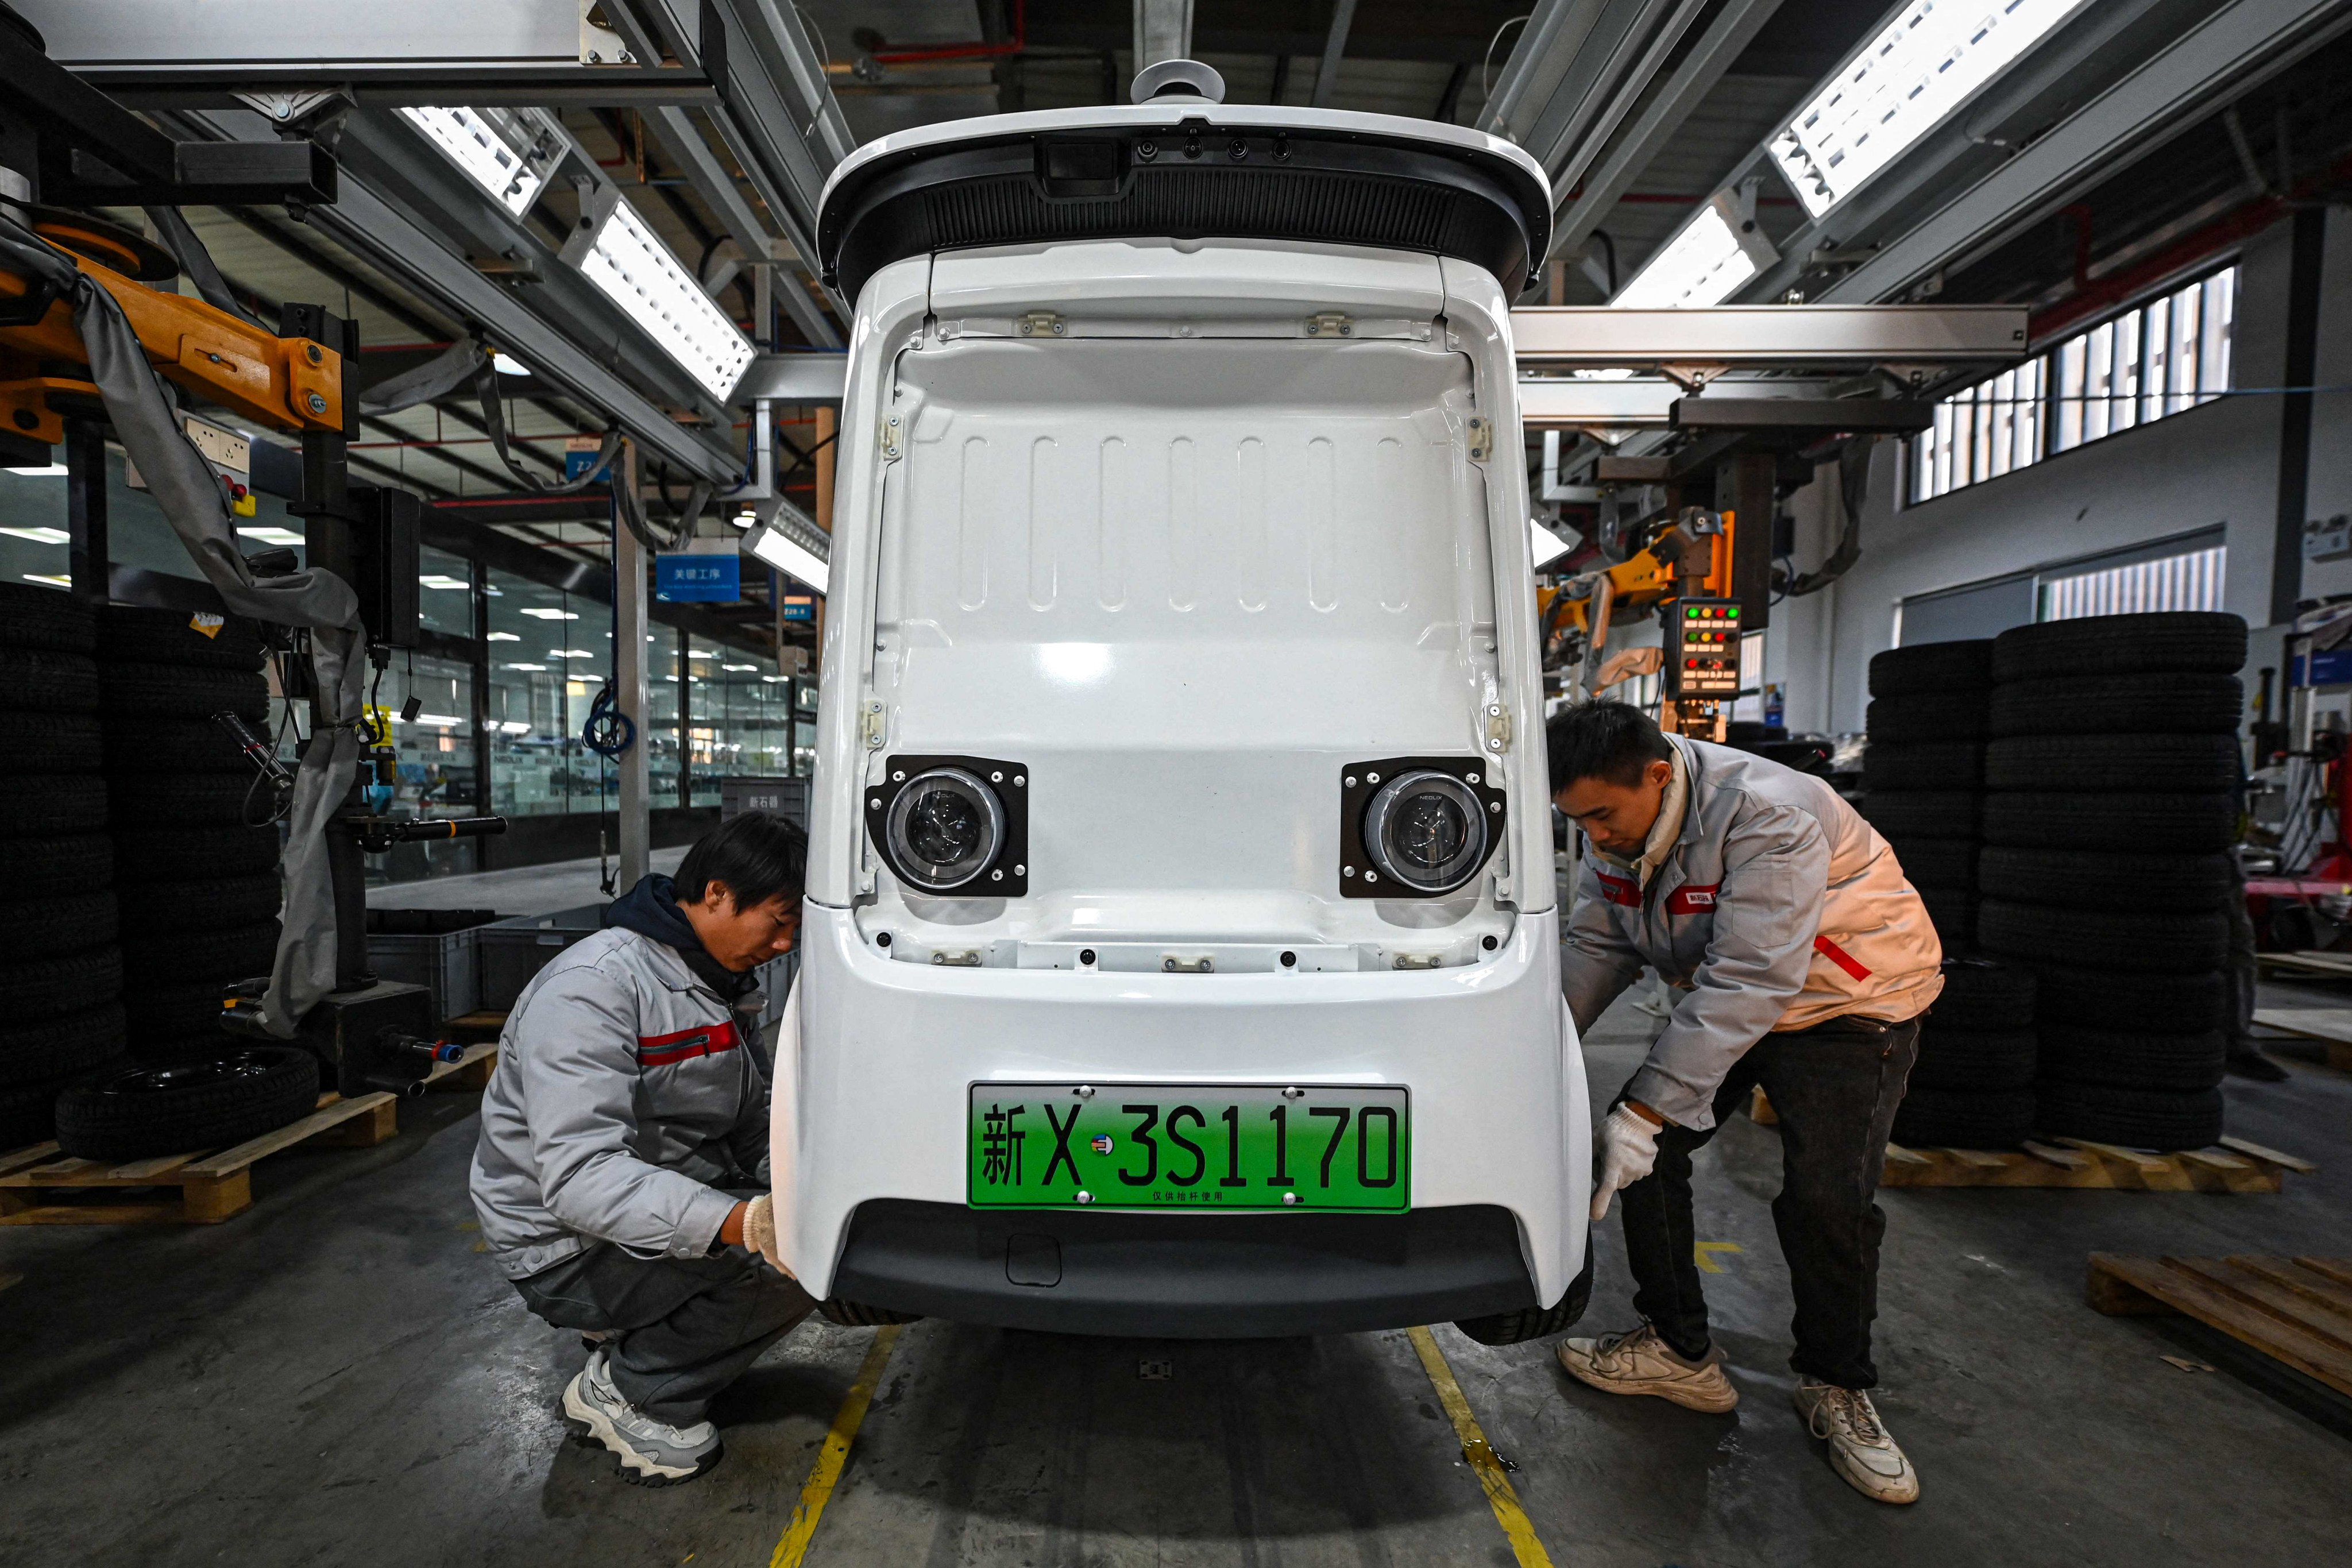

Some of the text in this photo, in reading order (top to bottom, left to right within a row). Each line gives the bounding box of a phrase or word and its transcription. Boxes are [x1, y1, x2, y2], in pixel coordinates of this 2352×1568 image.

[750, 795, 778, 808] 新石器
[1153, 1191, 1222, 1202] 仅供抬杆使用
